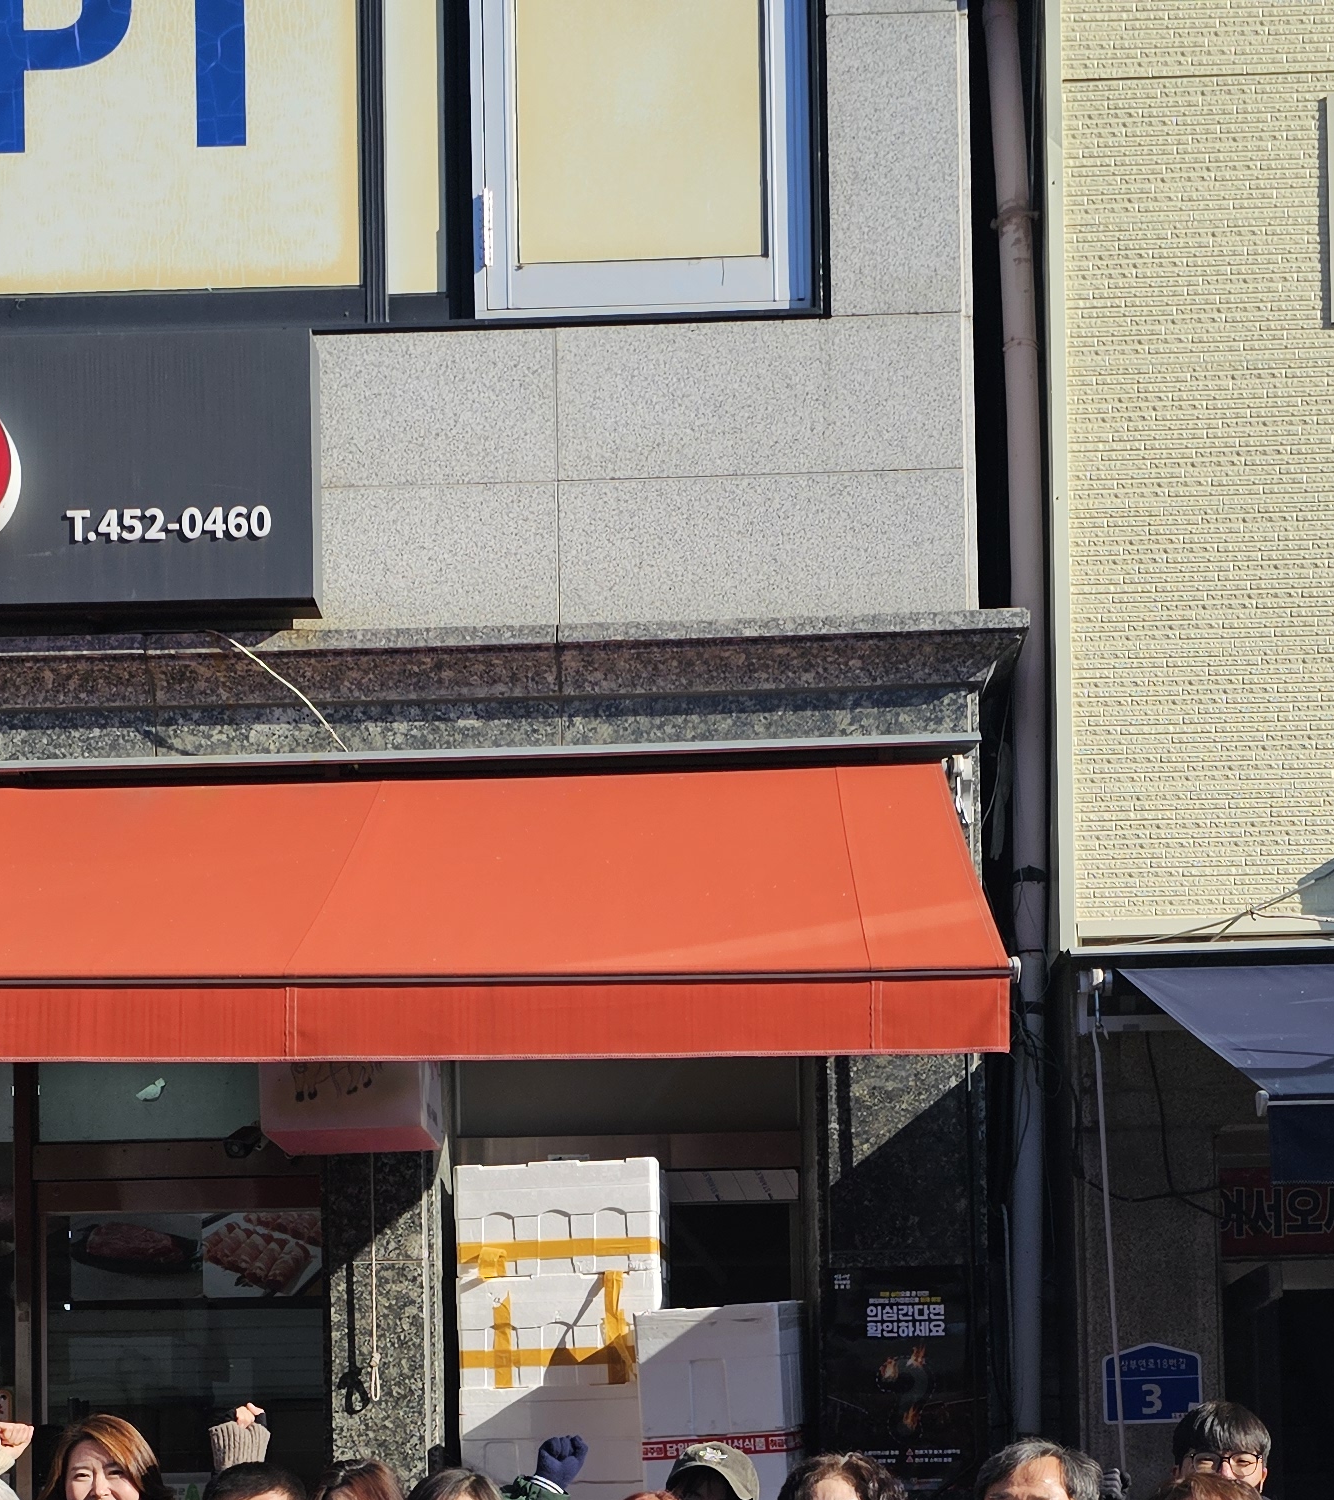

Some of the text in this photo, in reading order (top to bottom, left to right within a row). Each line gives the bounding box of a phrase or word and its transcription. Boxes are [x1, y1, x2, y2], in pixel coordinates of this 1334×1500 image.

[65, 503, 272, 544] T.452-0460
[866, 1303, 946, 1321] 의심간다면
[866, 1321, 946, 1338] 확인하세요
[1141, 1383, 1163, 1415] 3
